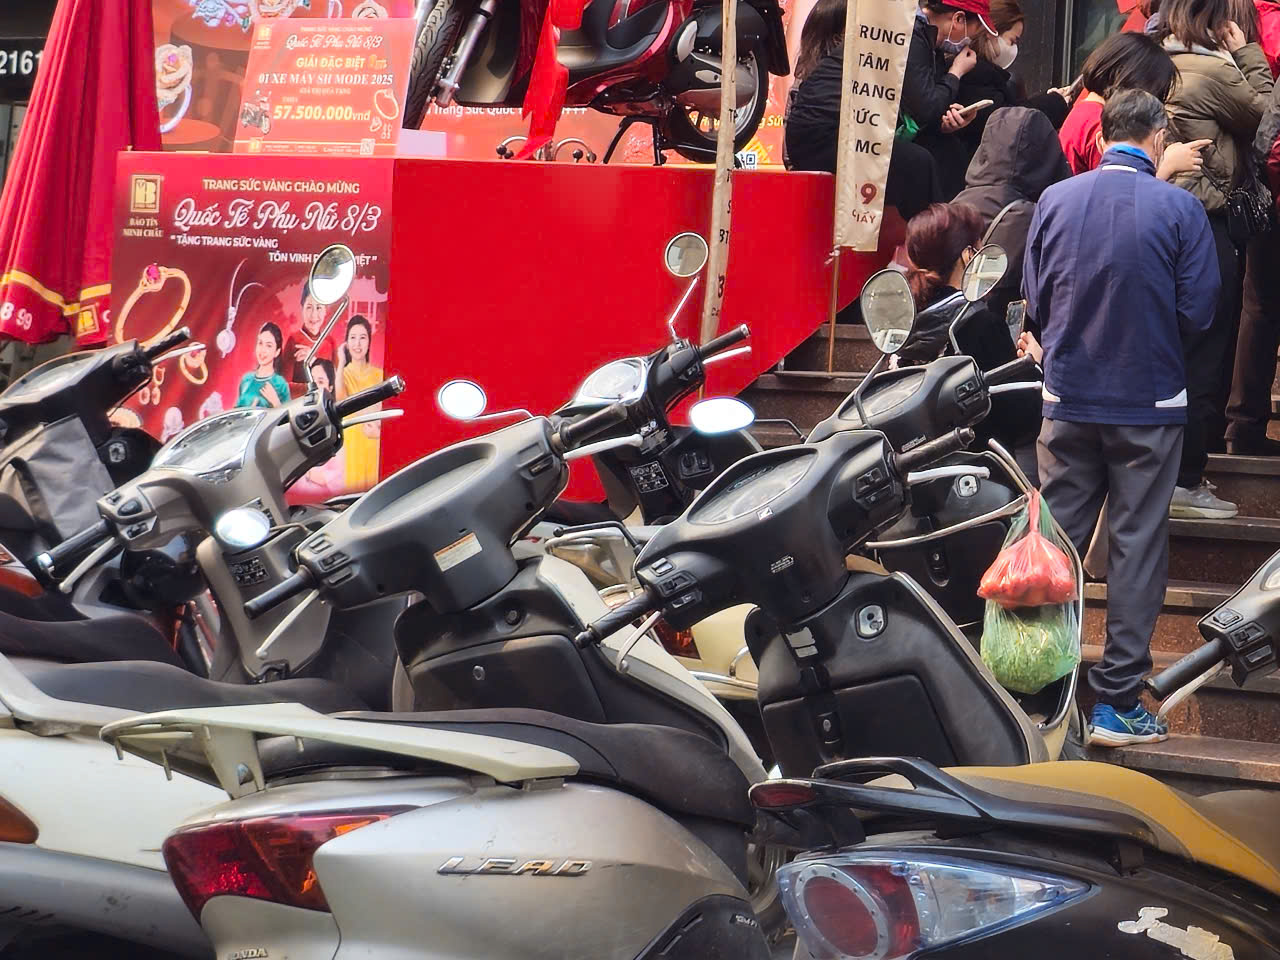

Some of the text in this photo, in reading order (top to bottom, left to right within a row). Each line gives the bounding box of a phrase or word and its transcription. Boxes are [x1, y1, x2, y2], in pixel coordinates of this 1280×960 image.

[859, 24, 907, 47] RUNG
[851, 80, 897, 102] RANG
[853, 108, 881, 128] ỨC
[203, 177, 360, 194] TRANG SỨC VÀNG CHÀO MỪNG
[173, 197, 222, 231] Quốc
[253, 200, 301, 234] Phụ
[341, 202, 382, 236] 8/3
[202, 236, 232, 247] TRANG
[233, 234, 251, 248] SỨC
[253, 236, 278, 249] VÀNG
[289, 253, 311, 263] VINH
[436, 855, 594, 877] LEAD
